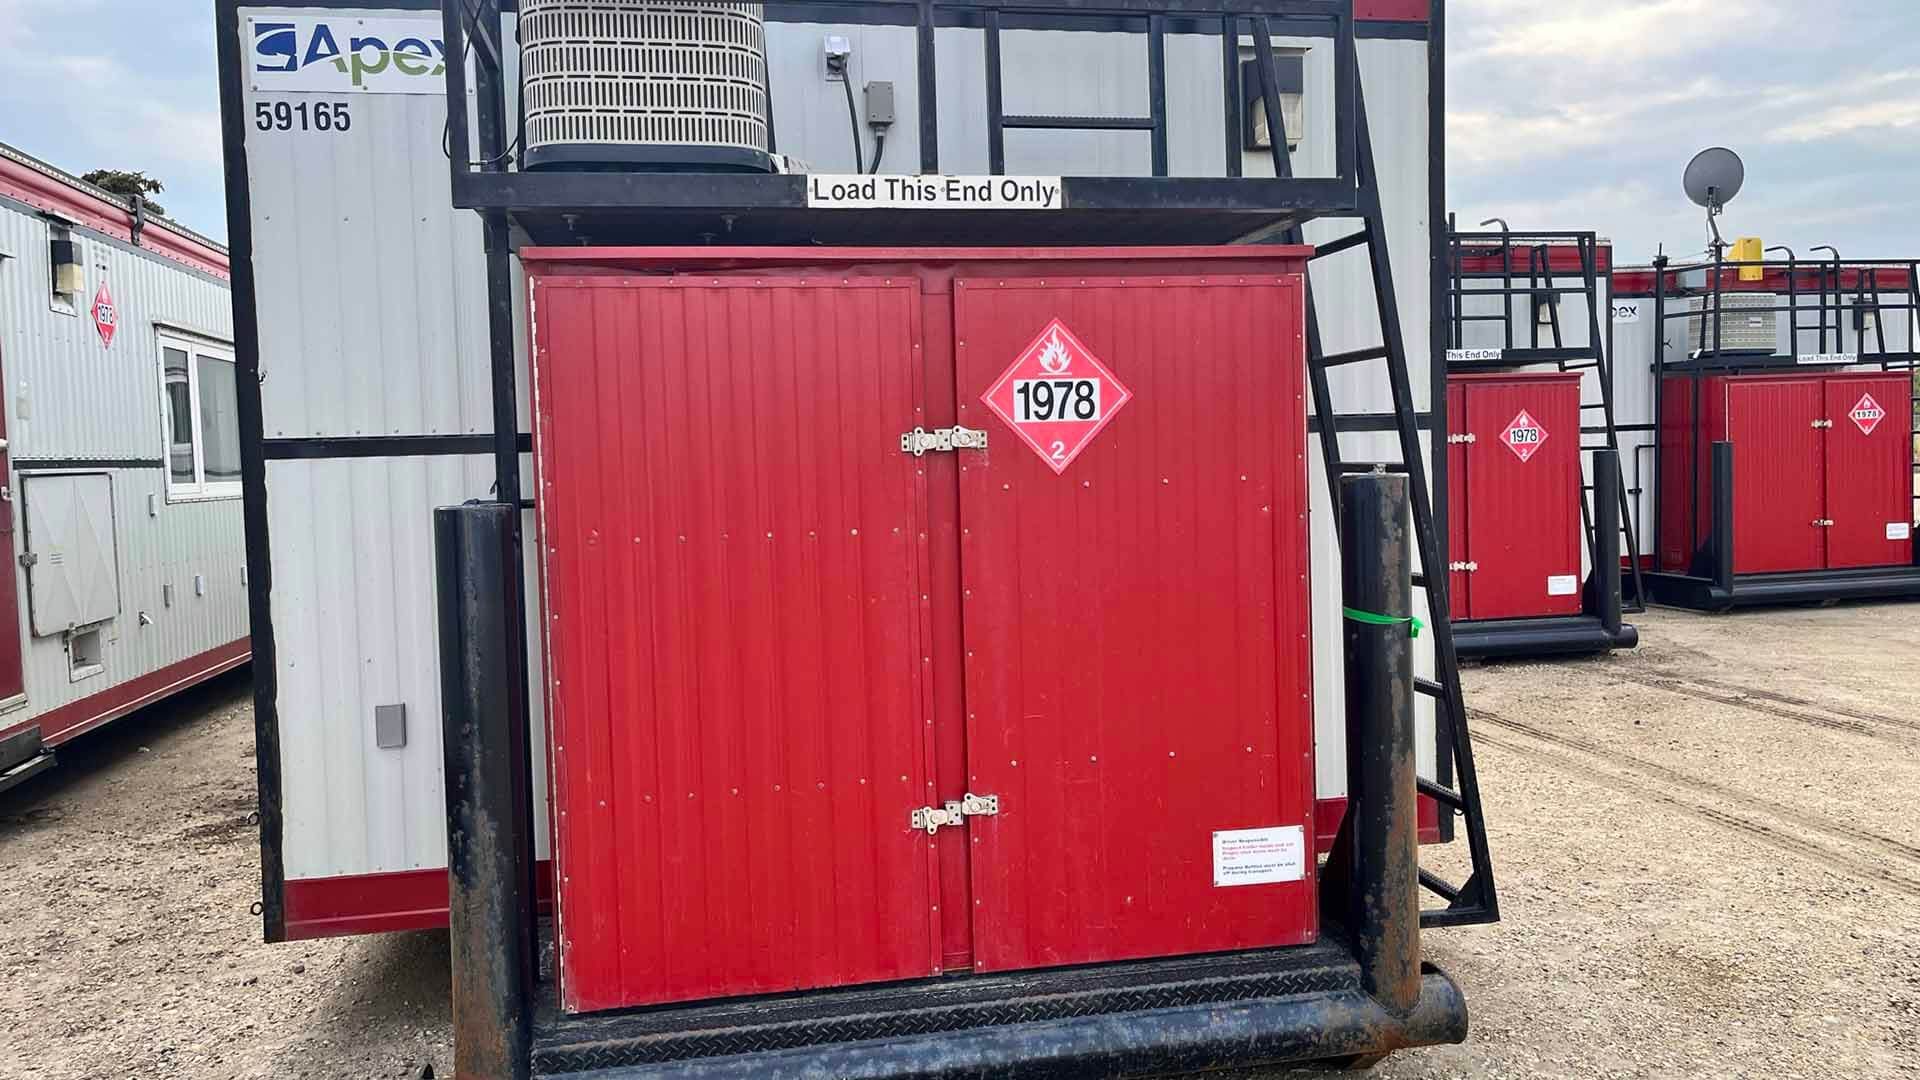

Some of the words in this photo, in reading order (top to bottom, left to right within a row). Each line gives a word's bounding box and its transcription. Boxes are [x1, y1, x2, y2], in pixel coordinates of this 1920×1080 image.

[256, 101, 351, 131] 59165
[814, 178, 876, 200] Load
[884, 178, 937, 201] This
[946, 179, 992, 201] End
[1001, 179, 1055, 207] Only
[1611, 306, 1637, 318] ex
[1447, 351, 1464, 359] This
[1465, 350, 1480, 358] End
[1482, 350, 1500, 359] Only
[1017, 380, 1095, 420] 1978
[1511, 429, 1537, 442] 1978
[1051, 441, 1065, 459] 2
